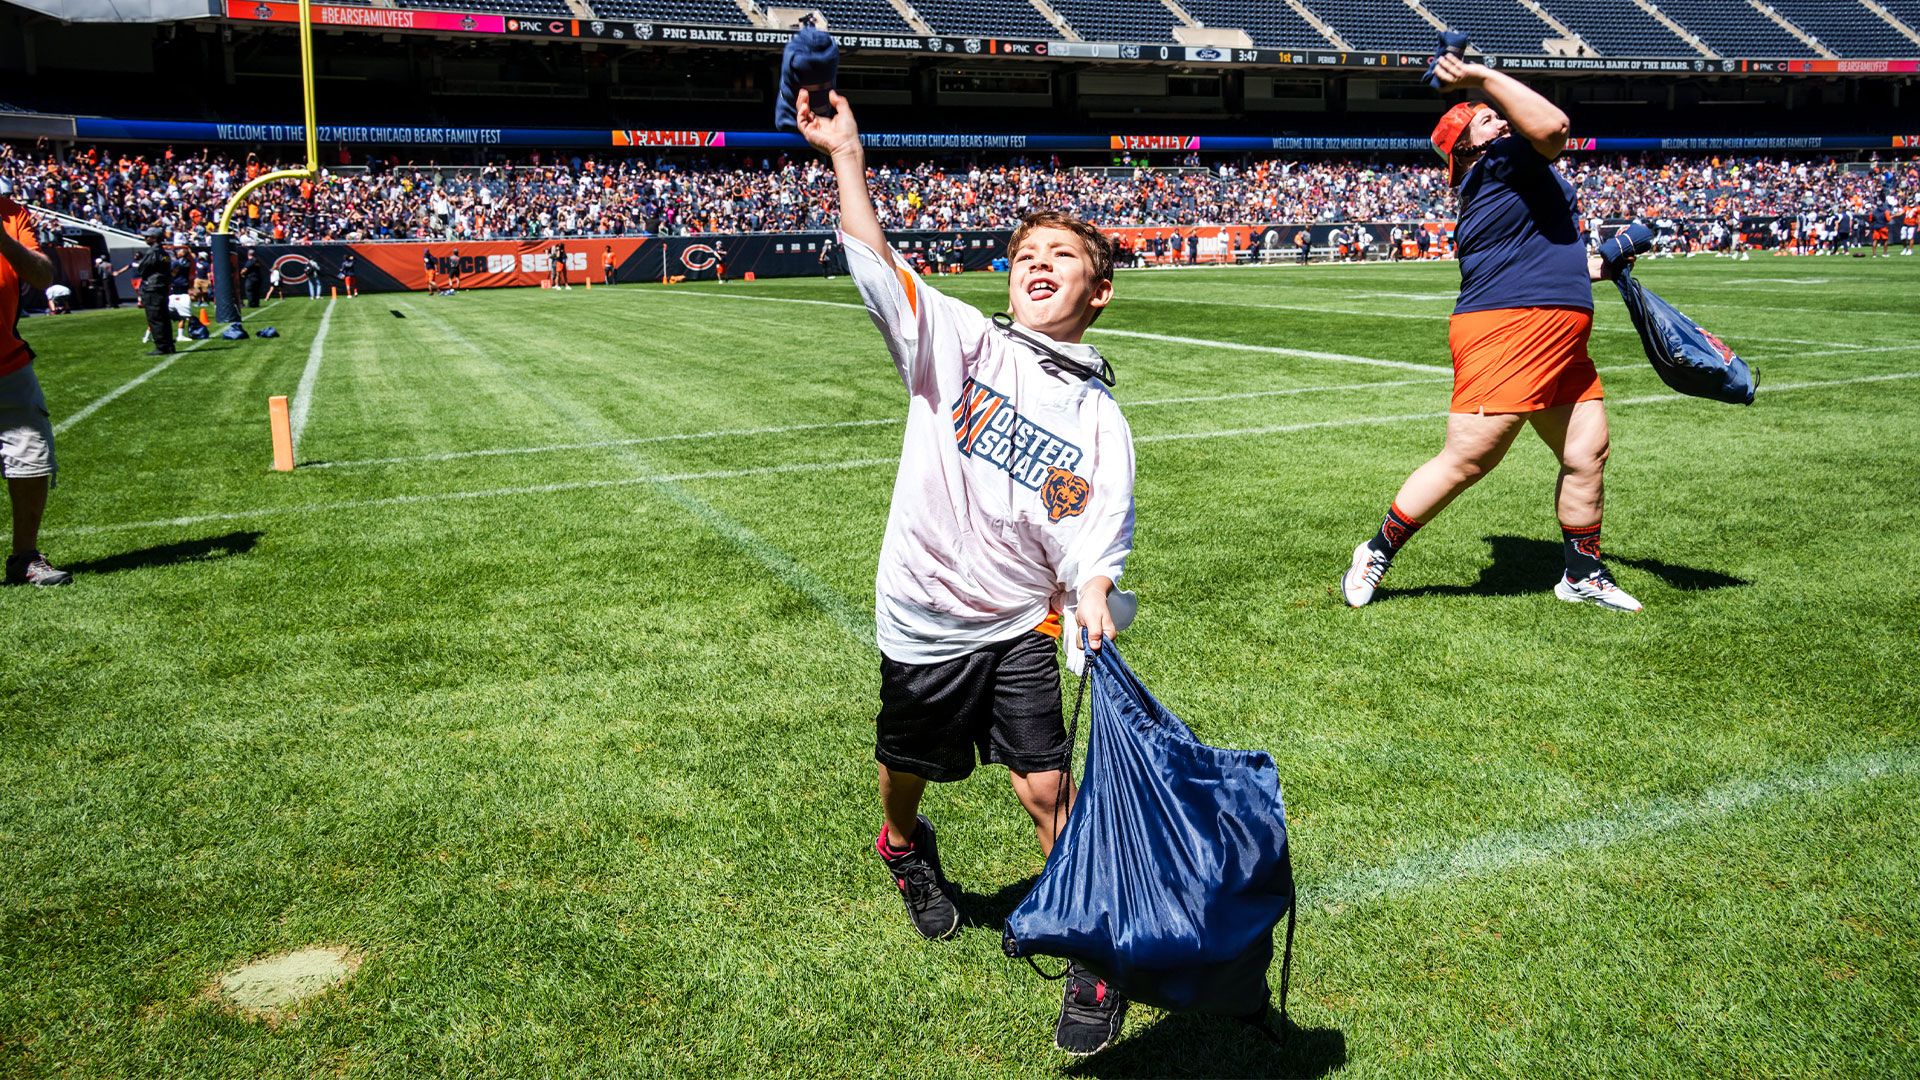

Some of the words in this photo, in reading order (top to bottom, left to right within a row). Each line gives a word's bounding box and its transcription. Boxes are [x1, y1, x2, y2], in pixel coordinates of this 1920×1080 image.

[322, 7, 414, 27] #BEARSFAMILYFEST
[520, 21, 542, 31] PNC
[662, 28, 687, 39] PNC
[689, 29, 727, 41] BANK.
[729, 31, 753, 41] THE
[755, 32, 792, 43] OFFICI
[843, 36, 858, 46] OF
[859, 37, 882, 47] THE
[884, 38, 922, 49] BEARS.
[1013, 44, 1029, 53] PNC
[1160, 46, 1168, 60] 0
[1200, 50, 1217, 59] Ford
[1238, 51, 1258, 61] 3:47
[1279, 52, 1291, 63] 1st
[1341, 54, 1347, 64] 7
[1364, 57, 1376, 65] PLAY
[1381, 55, 1387, 66] 0
[1408, 57, 1423, 65] PNC
[1503, 59, 1520, 67] PNC
[1521, 59, 1547, 68] BANK.
[1548, 60, 1565, 68] THE
[1567, 60, 1604, 69] OFFICIAL
[1606, 61, 1630, 69] BANK
[1631, 61, 1641, 69] OF
[1642, 61, 1659, 69] THE
[1661, 62, 1690, 70] BEARS.
[1760, 63, 1774, 71] PNC
[217, 124, 268, 140] WELCOME
[270, 126, 282, 140] TO
[285, 126, 304, 141] THE
[315, 126, 330, 141] 22
[333, 127, 367, 141] MEIJER
[370, 127, 411, 142] CHICAGO
[414, 128, 443, 143] BEARS
[446, 129, 478, 143] FAMILY
[480, 129, 501, 144] FEST
[631, 130, 708, 146] FAMILY
[867, 134, 880, 147] THE
[882, 134, 900, 147] 2022
[901, 134, 927, 147] MEIJER
[928, 135, 959, 147] CHICAGO
[960, 135, 982, 147] BEARS
[984, 135, 1009, 148] FAMILY
[1010, 135, 1026, 148] FEST
[1126, 135, 1187, 149] FAMILY
[1272, 137, 1302, 149] WELCOME
[1304, 137, 1312, 149] TO
[1313, 137, 1324, 149] THE
[1325, 138, 1340, 149] 2022
[1363, 138, 1389, 149] CHICAGO
[1389, 138, 1408, 149] BEARS
[1409, 138, 1430, 149] FAMILY
[1661, 137, 1689, 149] WELCOME
[1689, 137, 1697, 149] TO
[1698, 137, 1708, 149] THE
[1709, 138, 1722, 148] 2022
[1743, 138, 1768, 148] CHICAGO
[1768, 137, 1787, 148] BEARS
[1787, 137, 1808, 148] FAMILY
[1808, 137, 1821, 148] FEST
[437, 254, 516, 274] HCAGO
[521, 252, 588, 273] BERS
